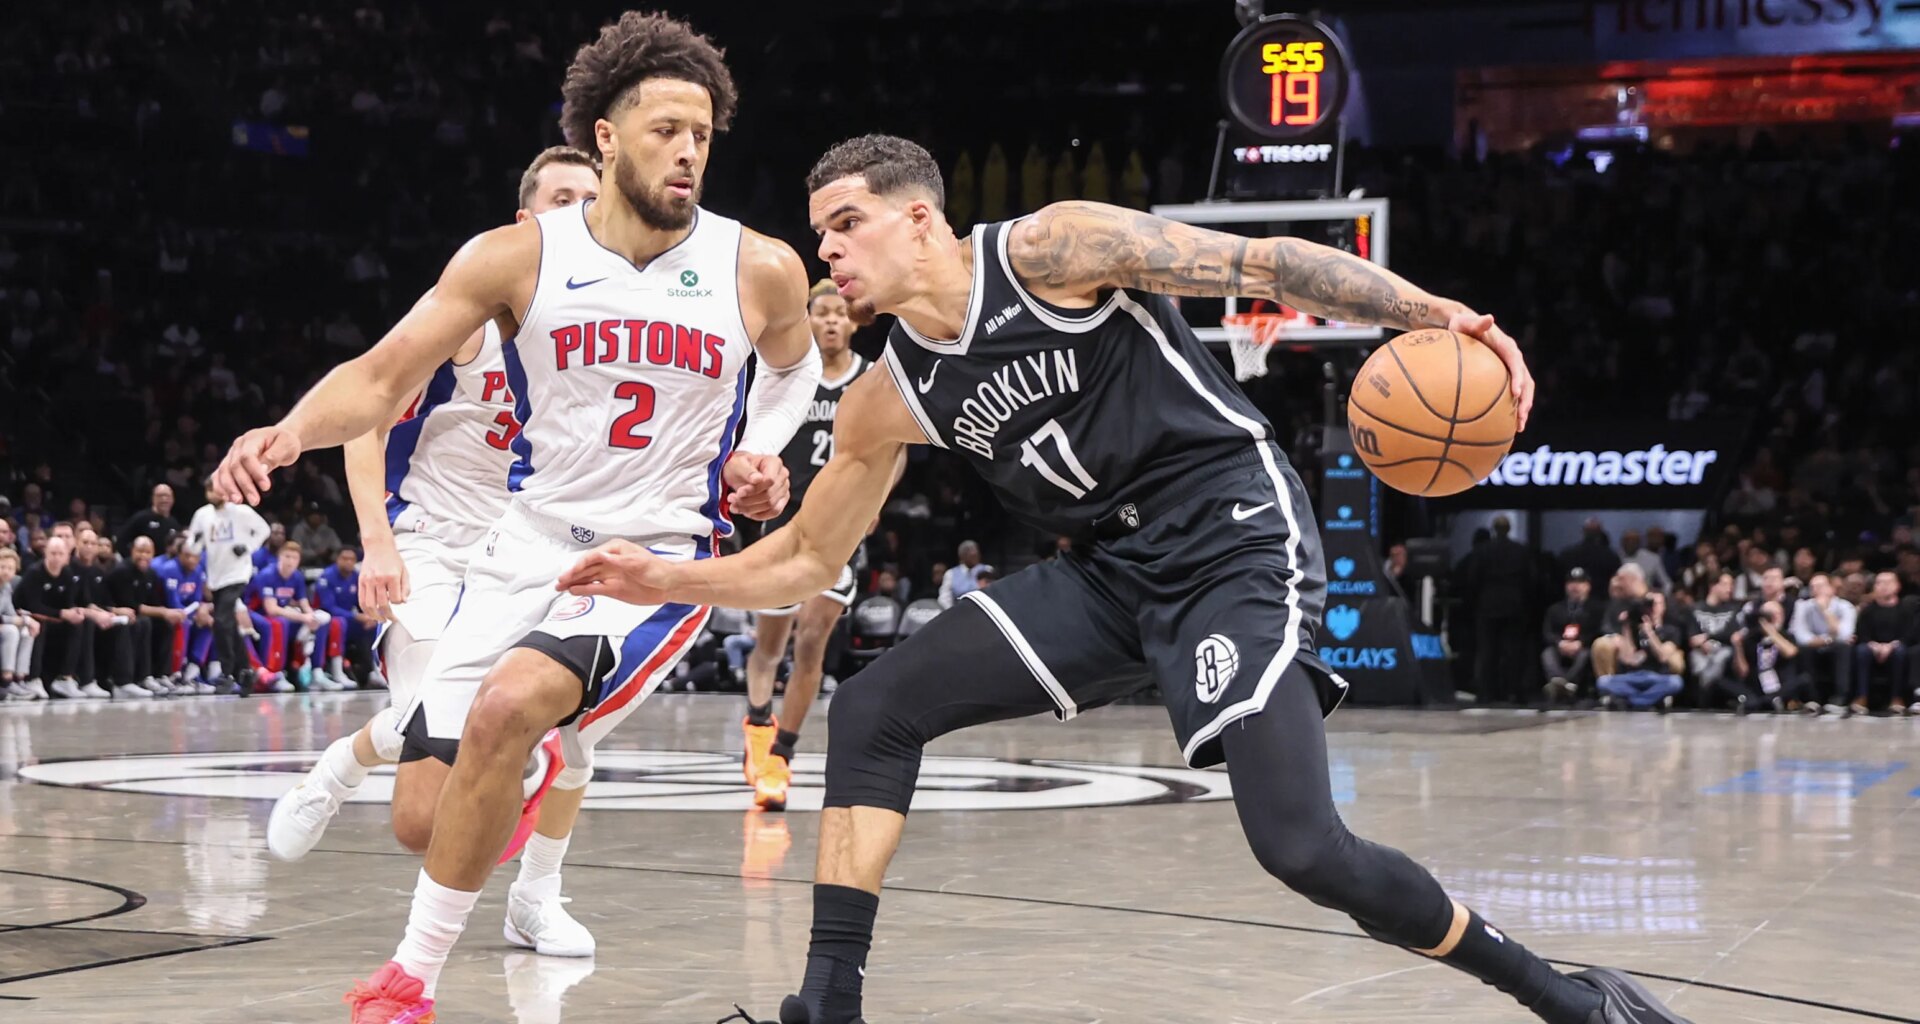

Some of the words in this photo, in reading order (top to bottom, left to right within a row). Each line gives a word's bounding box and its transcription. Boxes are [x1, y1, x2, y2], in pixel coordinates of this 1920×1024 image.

[1262, 42, 1324, 74] 5:55
[1270, 72, 1318, 126] 19
[1259, 144, 1332, 163] TISSOT
[667, 288, 713, 297] StockX
[985, 318, 998, 335] All
[994, 315, 1006, 327] In
[1001, 303, 1022, 320] Won
[550, 319, 725, 379] PISTONS
[608, 381, 656, 449] 2
[955, 348, 1079, 460] BROOKLYN
[1020, 418, 1098, 499] 17
